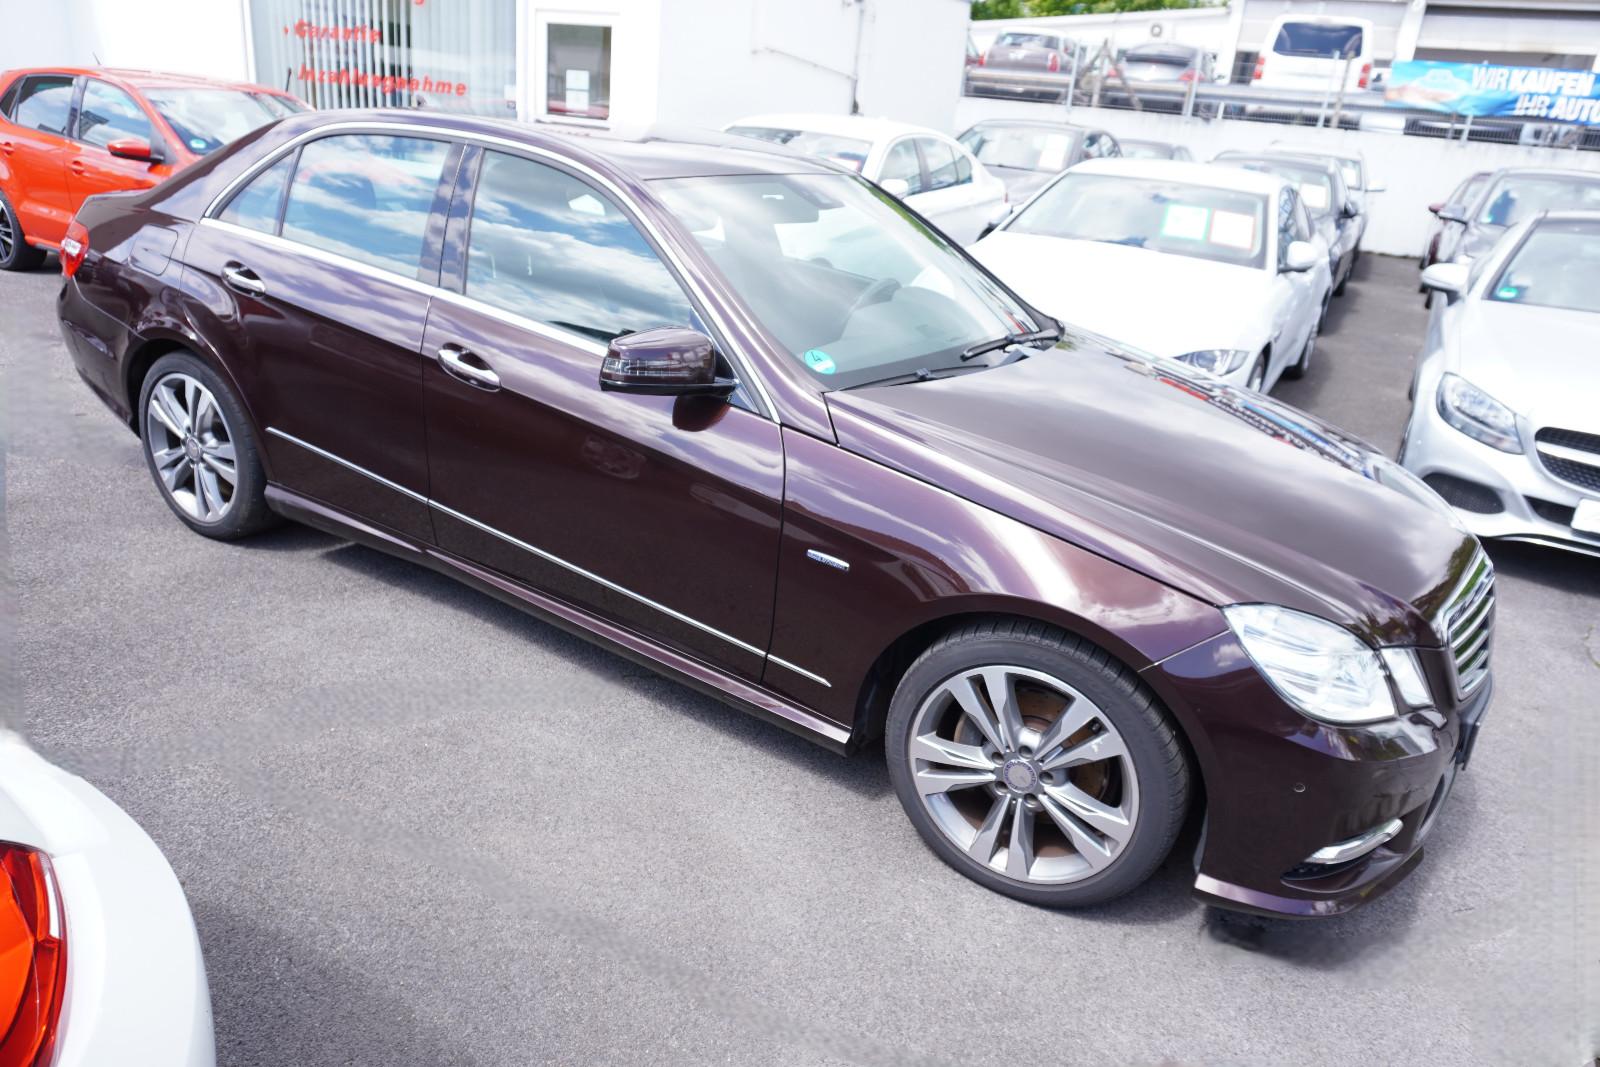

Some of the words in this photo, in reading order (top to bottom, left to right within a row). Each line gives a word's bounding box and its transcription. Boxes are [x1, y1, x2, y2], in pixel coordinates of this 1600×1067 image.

[295, 19, 383, 43] Garantie
[1472, 66, 1509, 91] WIR
[1509, 69, 1596, 97] KAUFEN
[1514, 94, 1551, 116] IHR
